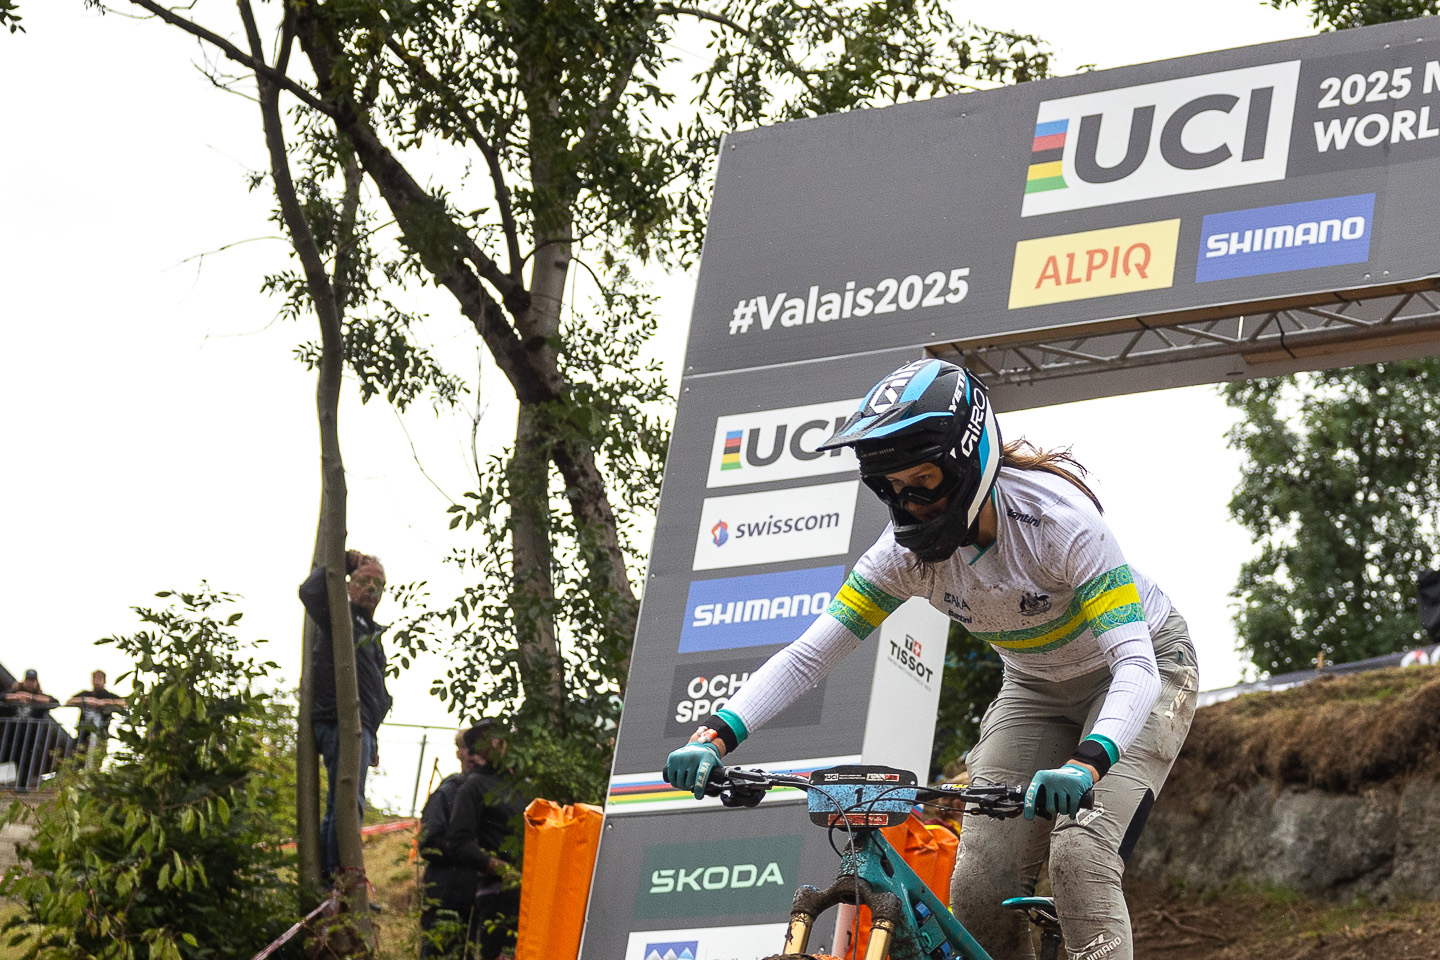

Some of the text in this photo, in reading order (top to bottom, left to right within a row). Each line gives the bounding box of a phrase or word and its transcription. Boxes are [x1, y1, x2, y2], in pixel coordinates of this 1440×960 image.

[1317, 65, 1412, 109] 2025
[1073, 86, 1274, 185] UCI
[1205, 215, 1366, 259] SHIMANO
[1034, 242, 1152, 290] ALPIQ
[728, 267, 971, 336] #Valais2025
[745, 416, 847, 468] UCI
[960, 387, 986, 458] GIRO
[735, 512, 840, 539] swisscom
[692, 591, 832, 628] SHIMANO
[889, 639, 934, 683] TISSOT
[675, 697, 729, 723] SPO
